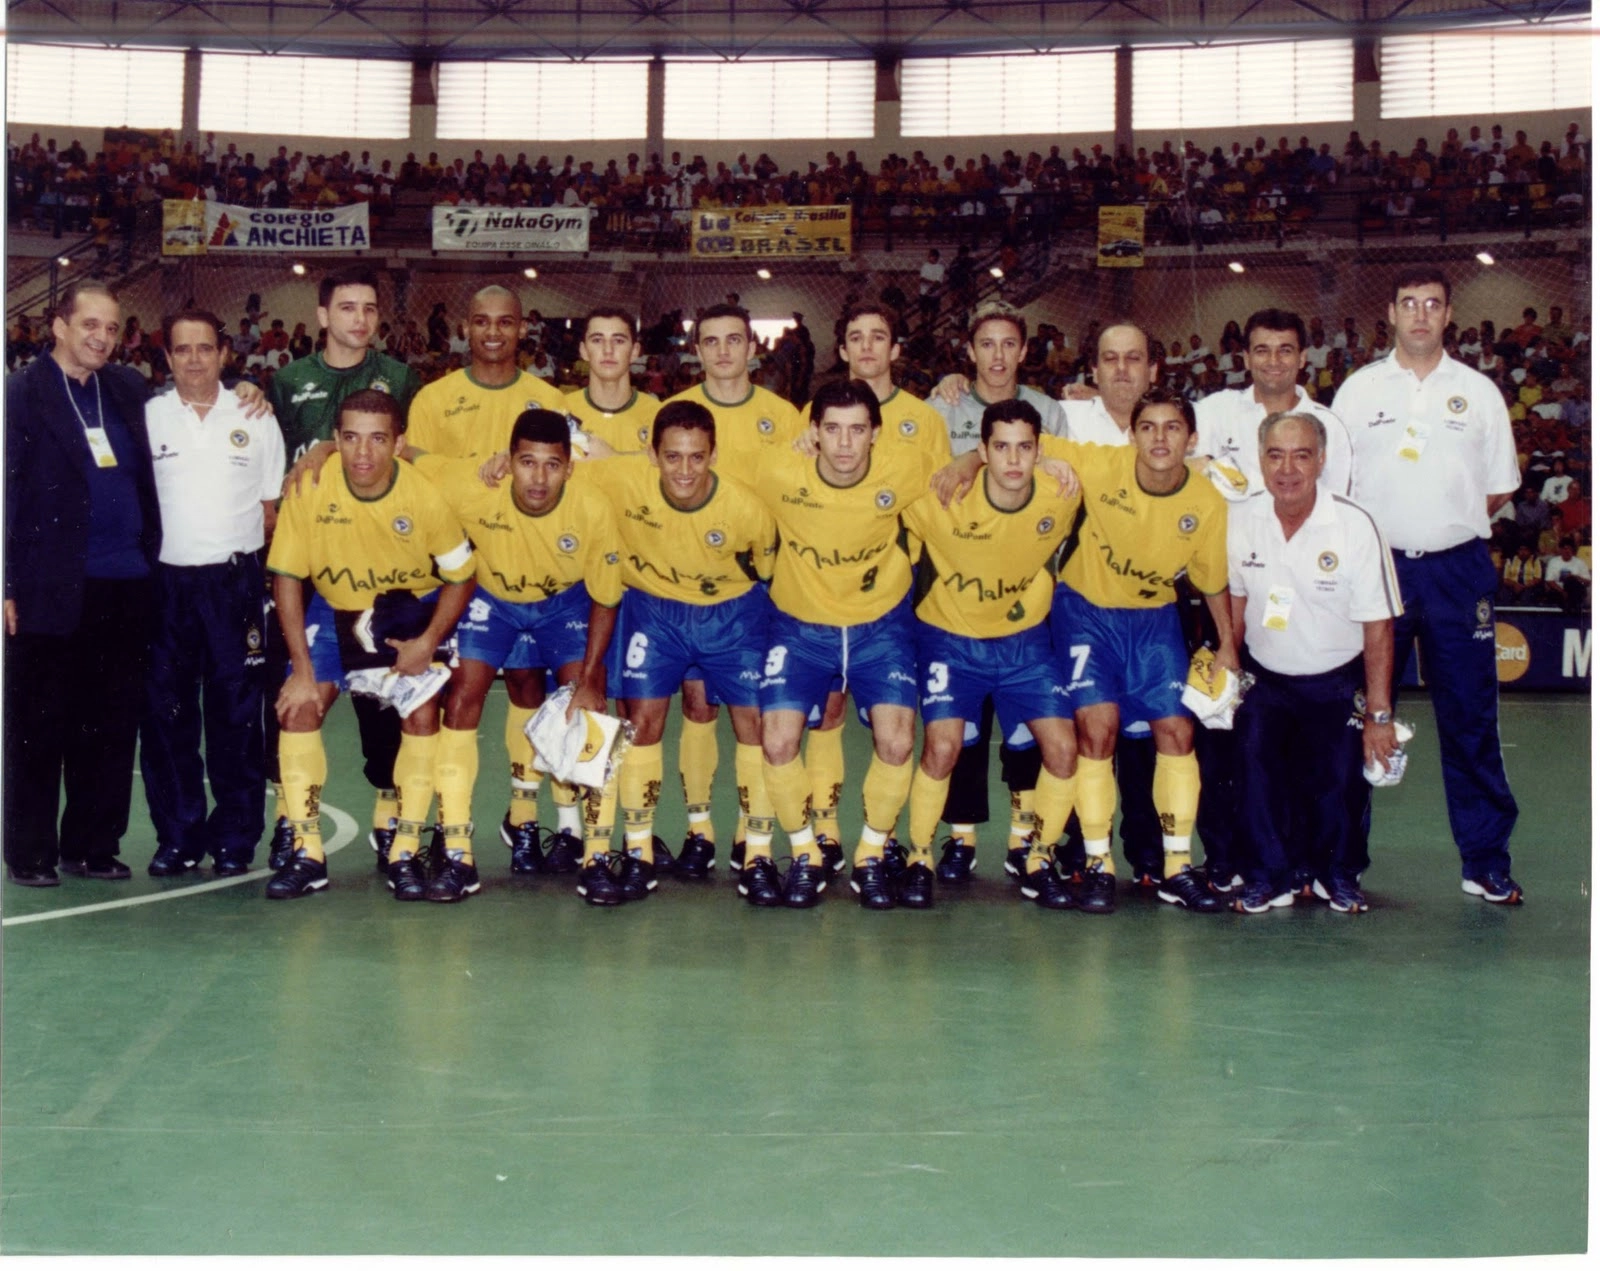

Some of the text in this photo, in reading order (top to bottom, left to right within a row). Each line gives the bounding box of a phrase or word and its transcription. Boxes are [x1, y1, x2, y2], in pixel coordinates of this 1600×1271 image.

[485, 211, 582, 232] NakaGym
[246, 225, 366, 246] ANCHIETA
[741, 236, 846, 254] BRASIL
[950, 431, 980, 440] DalPon
[782, 494, 824, 509] DalPonte
[1100, 494, 1136, 516] DalPonte
[625, 510, 662, 530] DalPonte
[952, 528, 992, 540] DalPonte
[316, 566, 426, 592] Malwee
[860, 565, 878, 592] 9
[626, 631, 648, 668] 6
[1562, 628, 1591, 678] M
[764, 646, 788, 677] 9
[1070, 644, 1091, 681] 7
[927, 661, 948, 694] 3
